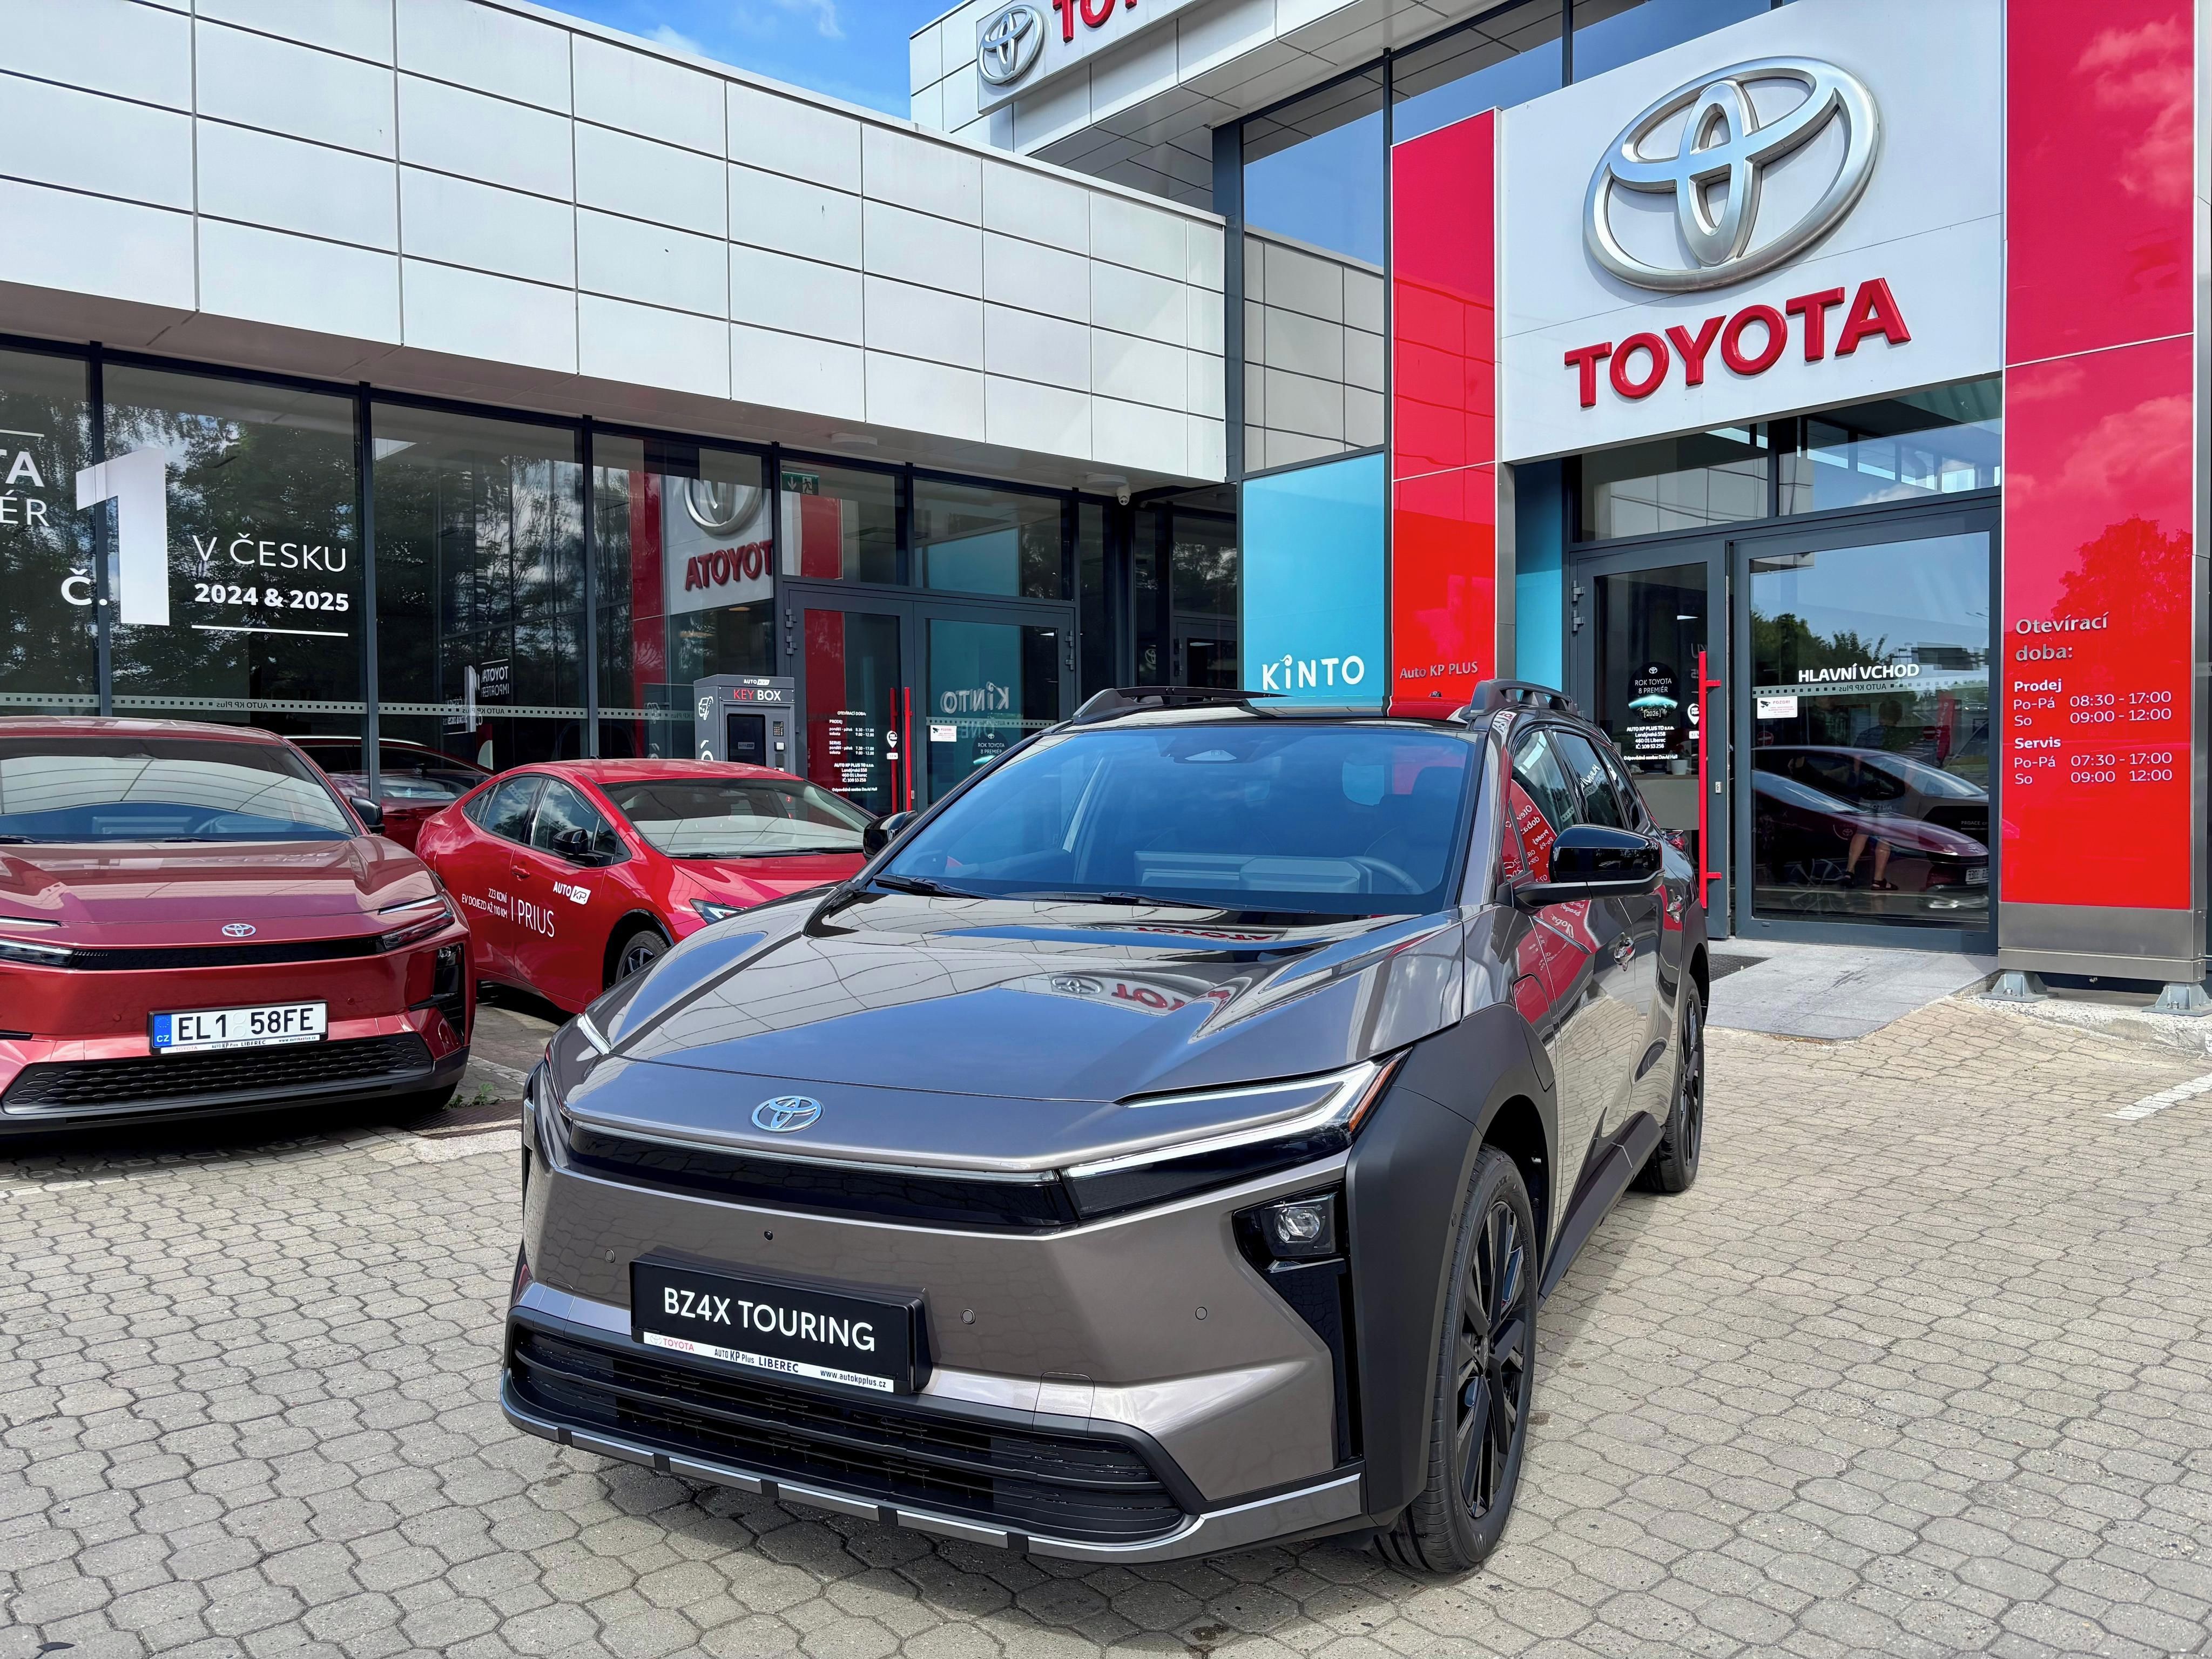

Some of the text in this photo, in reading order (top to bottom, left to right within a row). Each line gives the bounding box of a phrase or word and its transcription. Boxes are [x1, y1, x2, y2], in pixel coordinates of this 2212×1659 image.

[1564, 277, 1912, 408] TOYOTA
[0, 449, 45, 487] A
[76, 447, 170, 626] 1
[192, 532, 346, 572] V ČESKU
[195, 583, 349, 611] 2024 & 2025
[2015, 612, 2109, 635] Otevírací
[2015, 644, 2073, 661] doba:
[1400, 661, 1478, 679] Auto KP PLUS
[1798, 663, 1919, 682] HLAVNÍ VCHOD
[734, 689, 781, 701] KEY BOX
[1643, 685, 1668, 693] PREMIÉR
[2014, 679, 2062, 693] Prodej
[2013, 697, 2055, 710] Po-Pá
[2069, 693, 2114, 707] 08:30
[2128, 691, 2171, 704] 17:00
[2014, 715, 2032, 727] So
[2069, 711, 2114, 724] 09:00
[2128, 708, 2171, 721] 12:00
[2014, 737, 2061, 749] Servis
[2014, 755, 2056, 768] Po-Pá
[2071, 754, 2115, 767] 07:30
[2129, 752, 2173, 765] 17:00
[2014, 768, 2173, 785] So 09:00 12:00
[496, 892, 508, 903] KONÍ
[552, 881, 572, 897] AUTO
[462, 893, 468, 903] EV
[469, 896, 487, 911] DOJEZD
[487, 900, 493, 913] AŽ
[501, 907, 508, 919] KM
[518, 899, 555, 938] PRIUS
[178, 1008, 313, 1041] EL1 58FE
[664, 1287, 875, 1352] BZ4X TOURING
[663, 1337, 886, 1388] TOYOTA AUTO KP Plus LIBEREC www.autokpplus.cz
